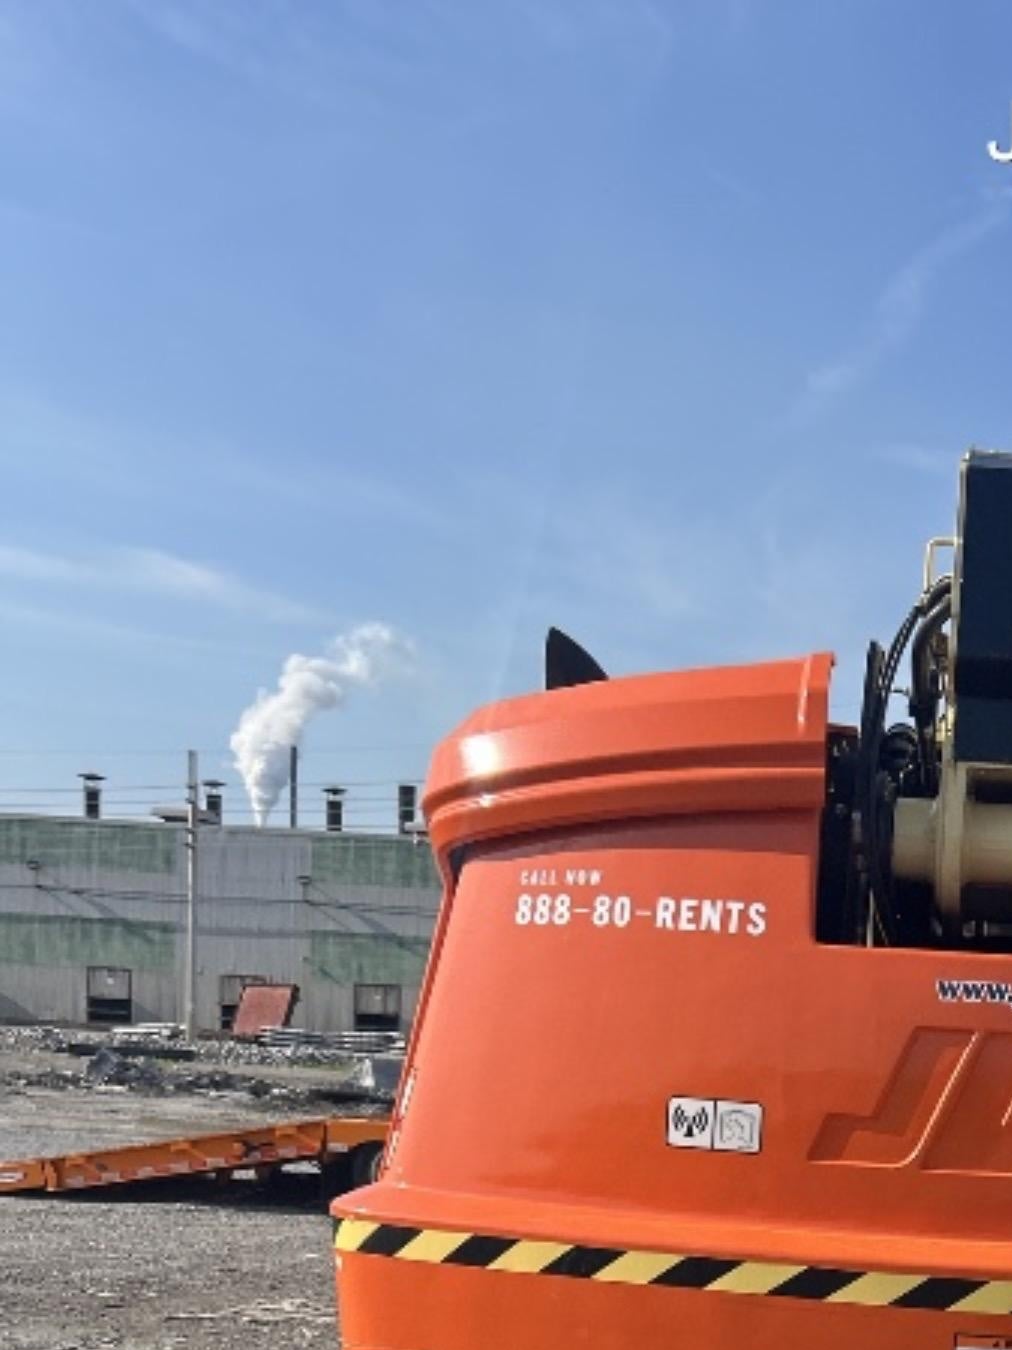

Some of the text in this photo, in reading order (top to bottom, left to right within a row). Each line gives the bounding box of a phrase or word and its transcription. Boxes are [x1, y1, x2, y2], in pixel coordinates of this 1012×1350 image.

[520, 869, 603, 886] CALL NOW
[515, 893, 767, 936] 888-80-RENTS
